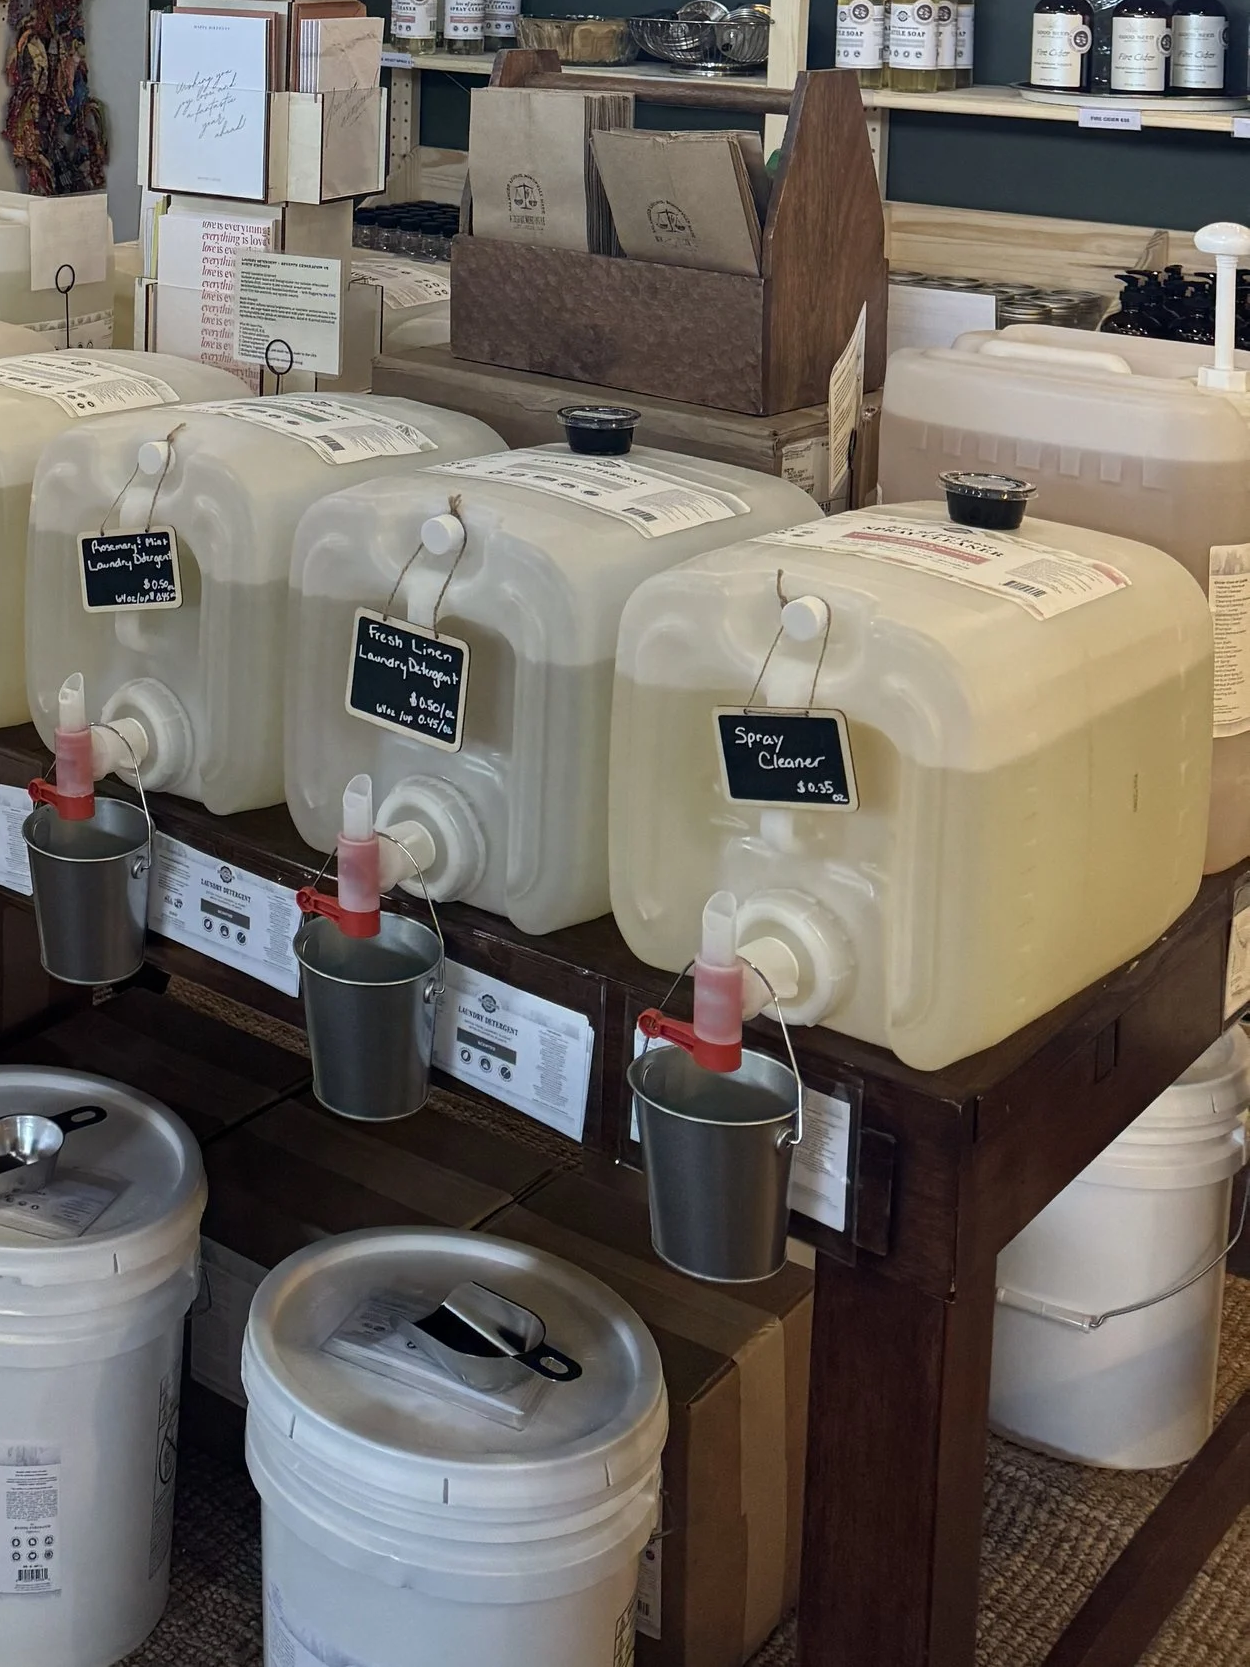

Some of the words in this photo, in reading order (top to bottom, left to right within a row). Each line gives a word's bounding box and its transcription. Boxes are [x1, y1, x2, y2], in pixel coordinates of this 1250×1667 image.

[1036, 48, 1048, 56] Fire
[1049, 48, 1070, 57] Cider
[1118, 53, 1133, 61] Fire
[1134, 53, 1156, 61] Cider
[1194, 51, 1216, 59] Cider
[202, 232, 240, 246] everything
[202, 241, 216, 253] love
[202, 254, 236, 269] everythin
[202, 265, 216, 277] love
[201, 289, 216, 301] love
[201, 313, 216, 325] love
[201, 337, 216, 349] love
[91, 539, 137, 554] Rosemary
[145, 537, 169, 547] Mint
[88, 557, 133, 571] Laundry
[133, 551, 172, 569] Detergent
[369, 624, 403, 649] Fresh
[412, 638, 453, 663] Linen
[359, 644, 407, 680] Laundry
[408, 657, 459, 689] Detergent
[409, 691, 418, 707] $
[734, 726, 784, 753] Spray
[758, 751, 826, 770] Cleaner
[796, 780, 806, 794] $
[807, 780, 834, 794] 0.35
[200, 878, 223, 892] LAUNDRY
[223, 887, 251, 903] DETERGENT
[458, 1005, 485, 1023] LAUNDRY
[485, 1018, 518, 1036] DETERGENT
